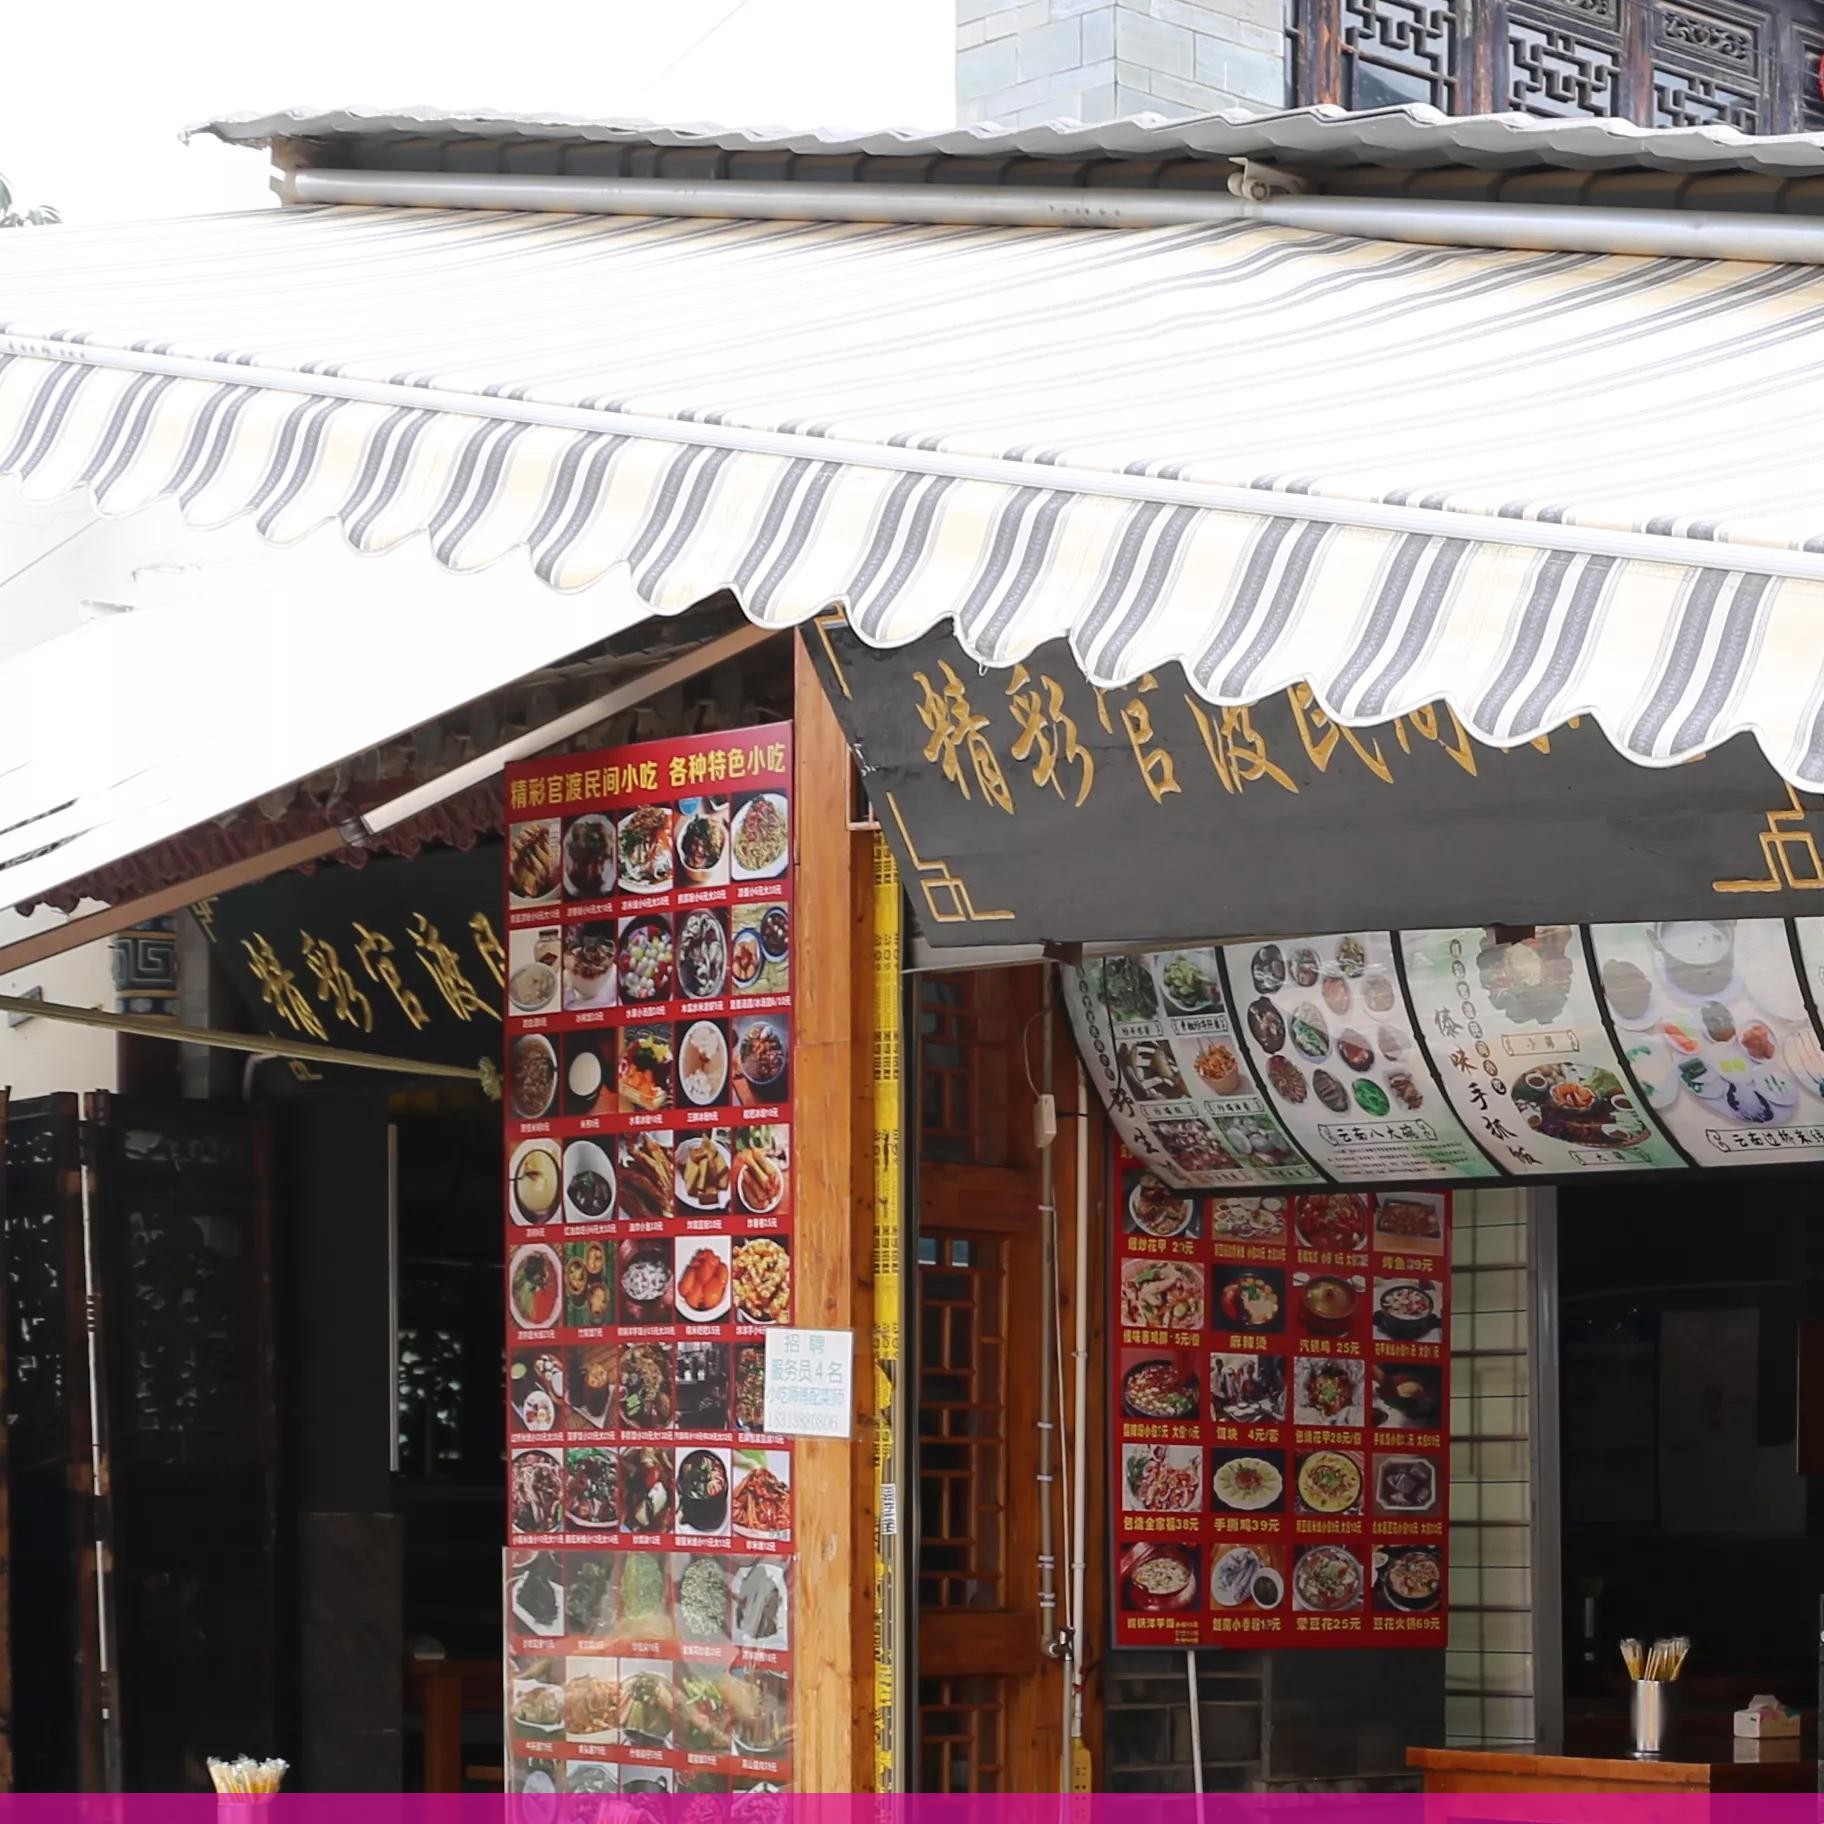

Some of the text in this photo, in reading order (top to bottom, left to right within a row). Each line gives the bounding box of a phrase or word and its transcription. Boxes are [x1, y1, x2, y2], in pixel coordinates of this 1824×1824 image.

[510, 743, 786, 810] 精彩官渡民间小吃 各种特色小吃
